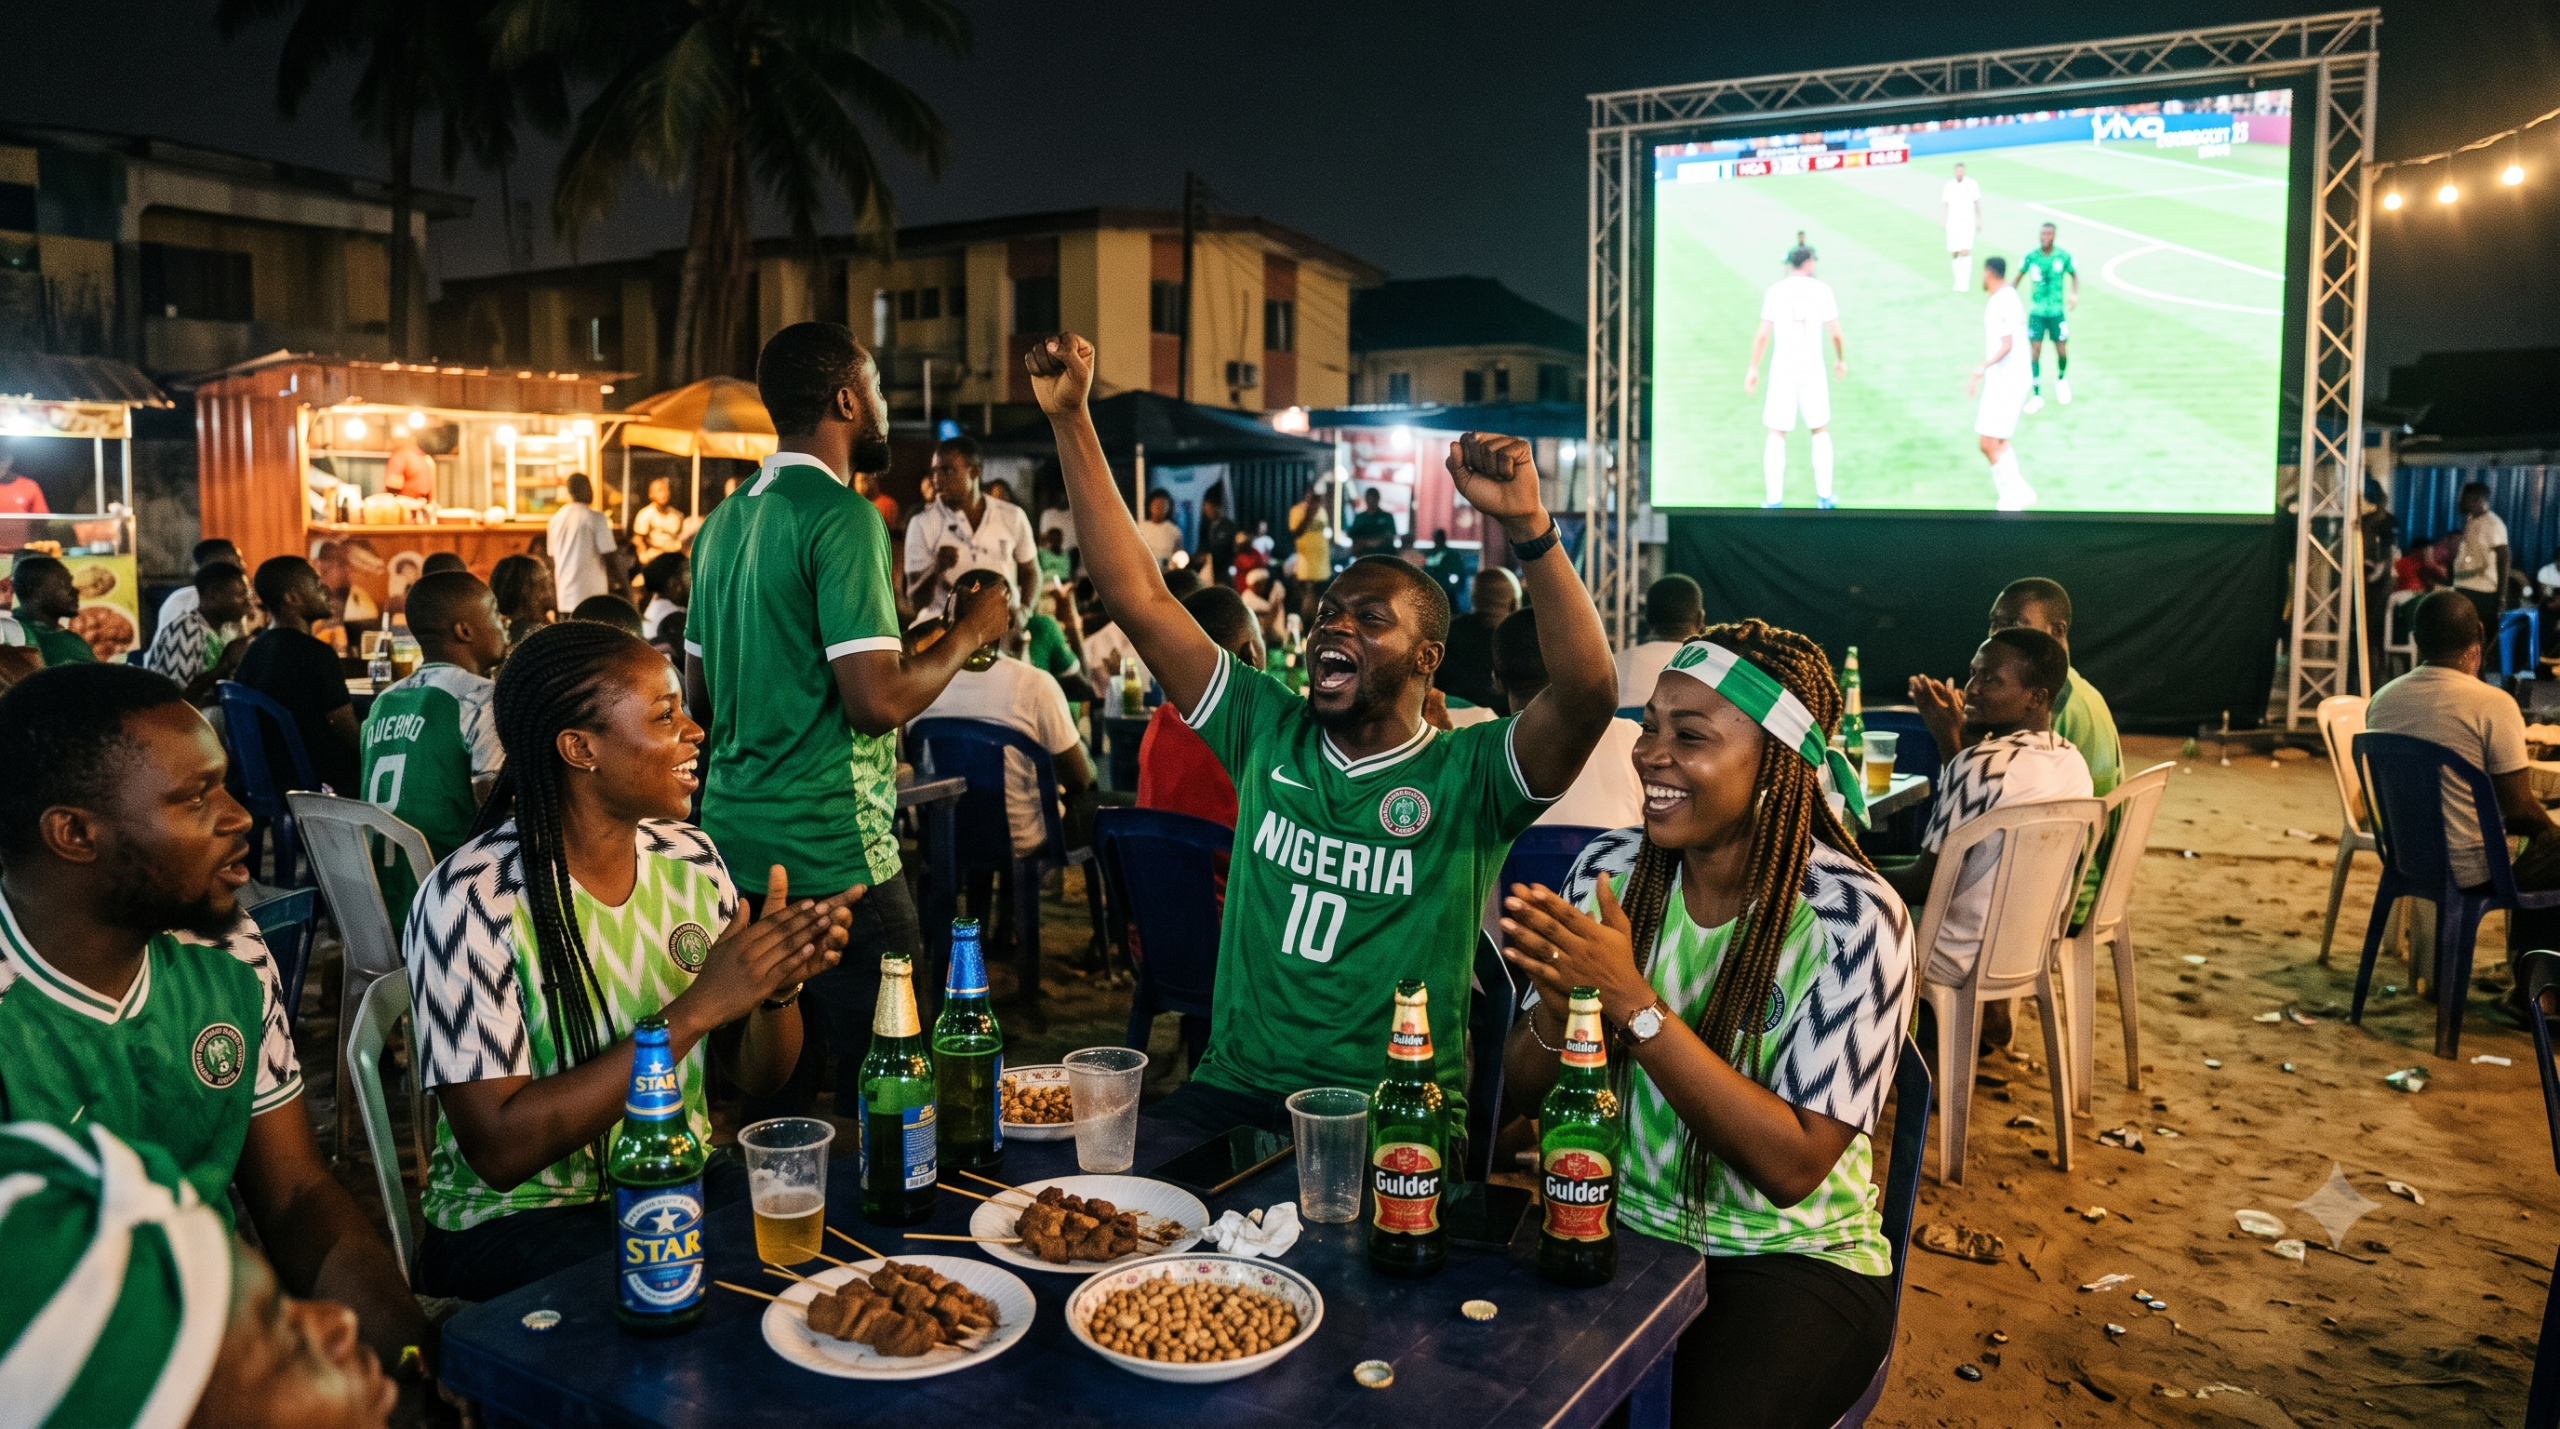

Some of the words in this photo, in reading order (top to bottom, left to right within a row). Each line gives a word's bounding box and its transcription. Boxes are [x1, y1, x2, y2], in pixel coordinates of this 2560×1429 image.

[1253, 810, 1413, 896] NIGERIA
[1281, 883, 1347, 963] 10
[635, 1073, 677, 1093] STAR
[1376, 1171, 1439, 1197] Gulder
[1546, 1176, 1610, 1203] Gulder
[626, 1229, 702, 1264] STAR
